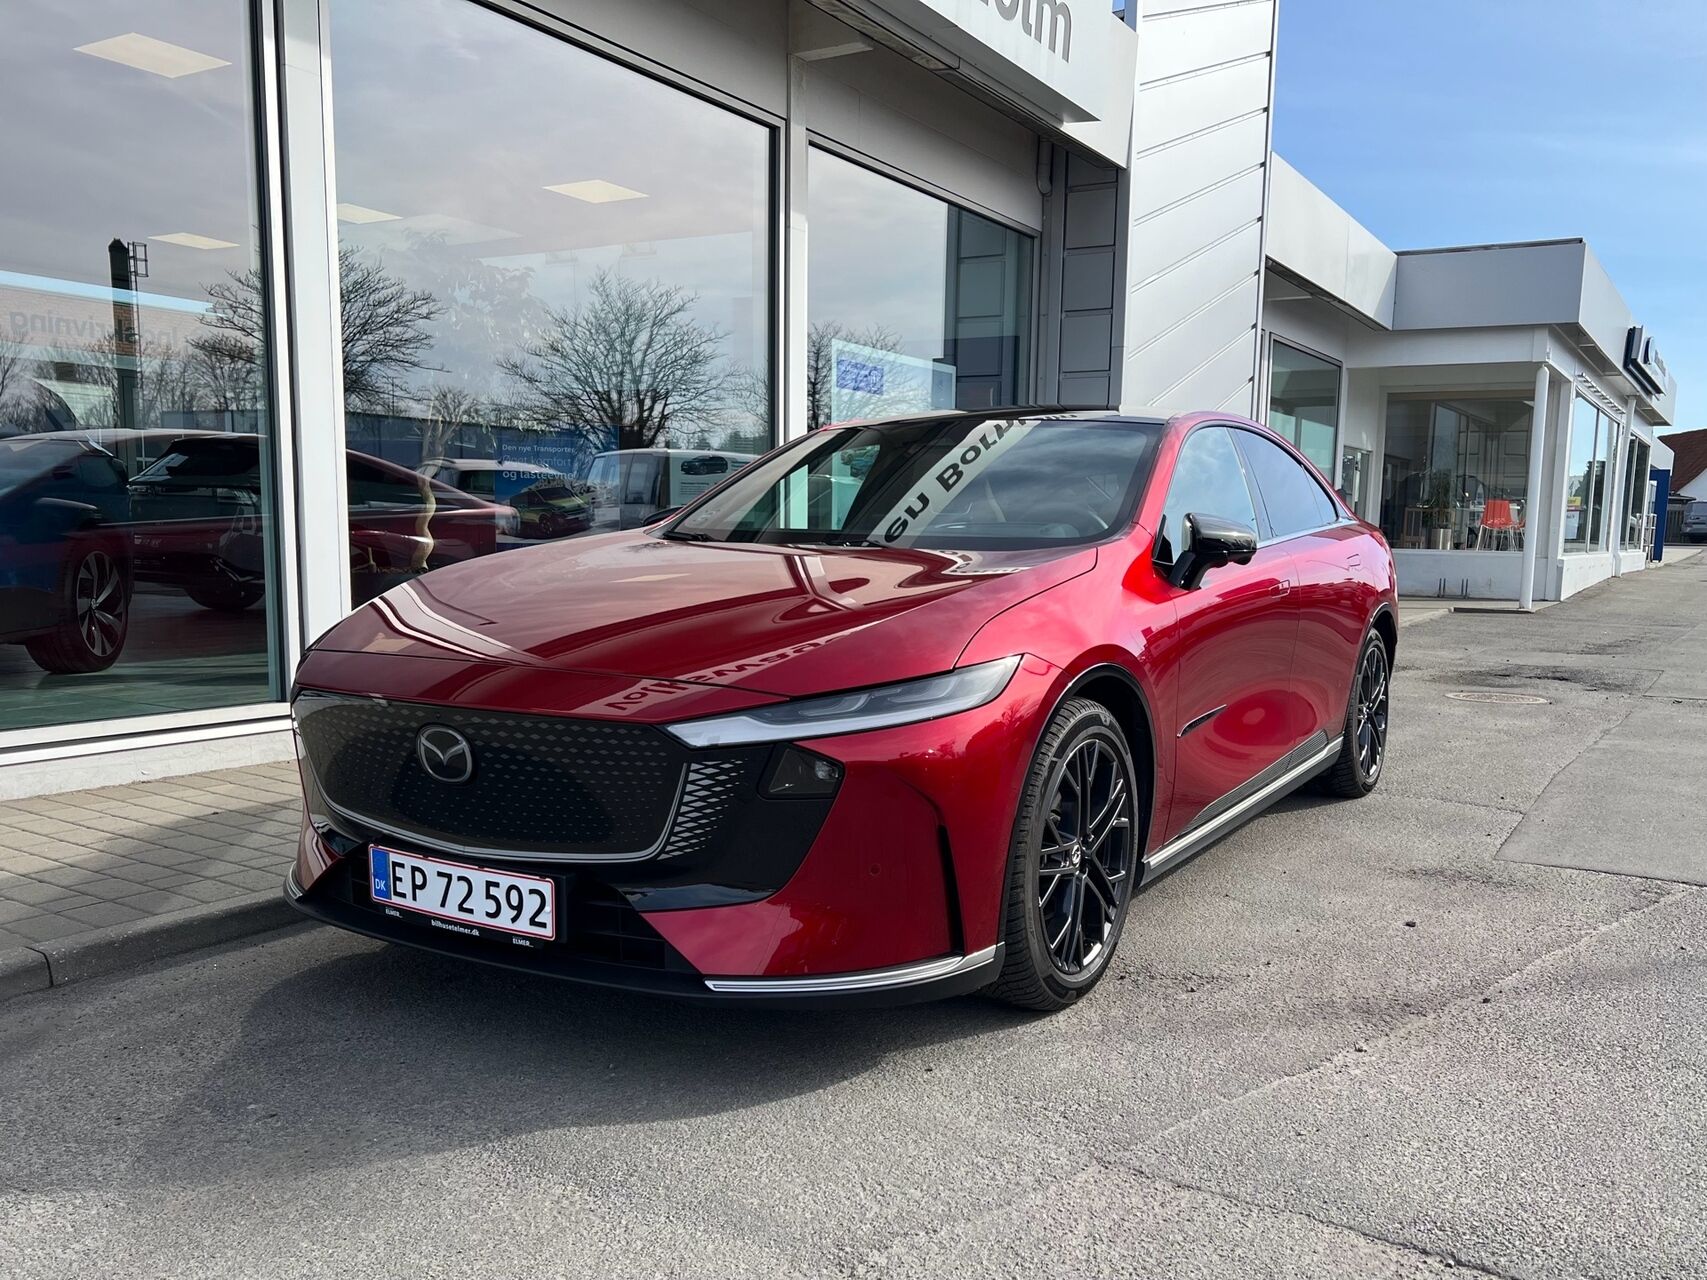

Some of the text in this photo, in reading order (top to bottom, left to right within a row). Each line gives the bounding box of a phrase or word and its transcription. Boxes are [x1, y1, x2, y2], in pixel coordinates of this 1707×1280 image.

[519, 445, 531, 453] nye
[502, 471, 517, 480] og
[375, 878, 387, 892] DK
[391, 860, 548, 929] EP 72 592
[431, 919, 480, 937] bilhusetelmer.dk
[512, 937, 531, 947] ELMER
